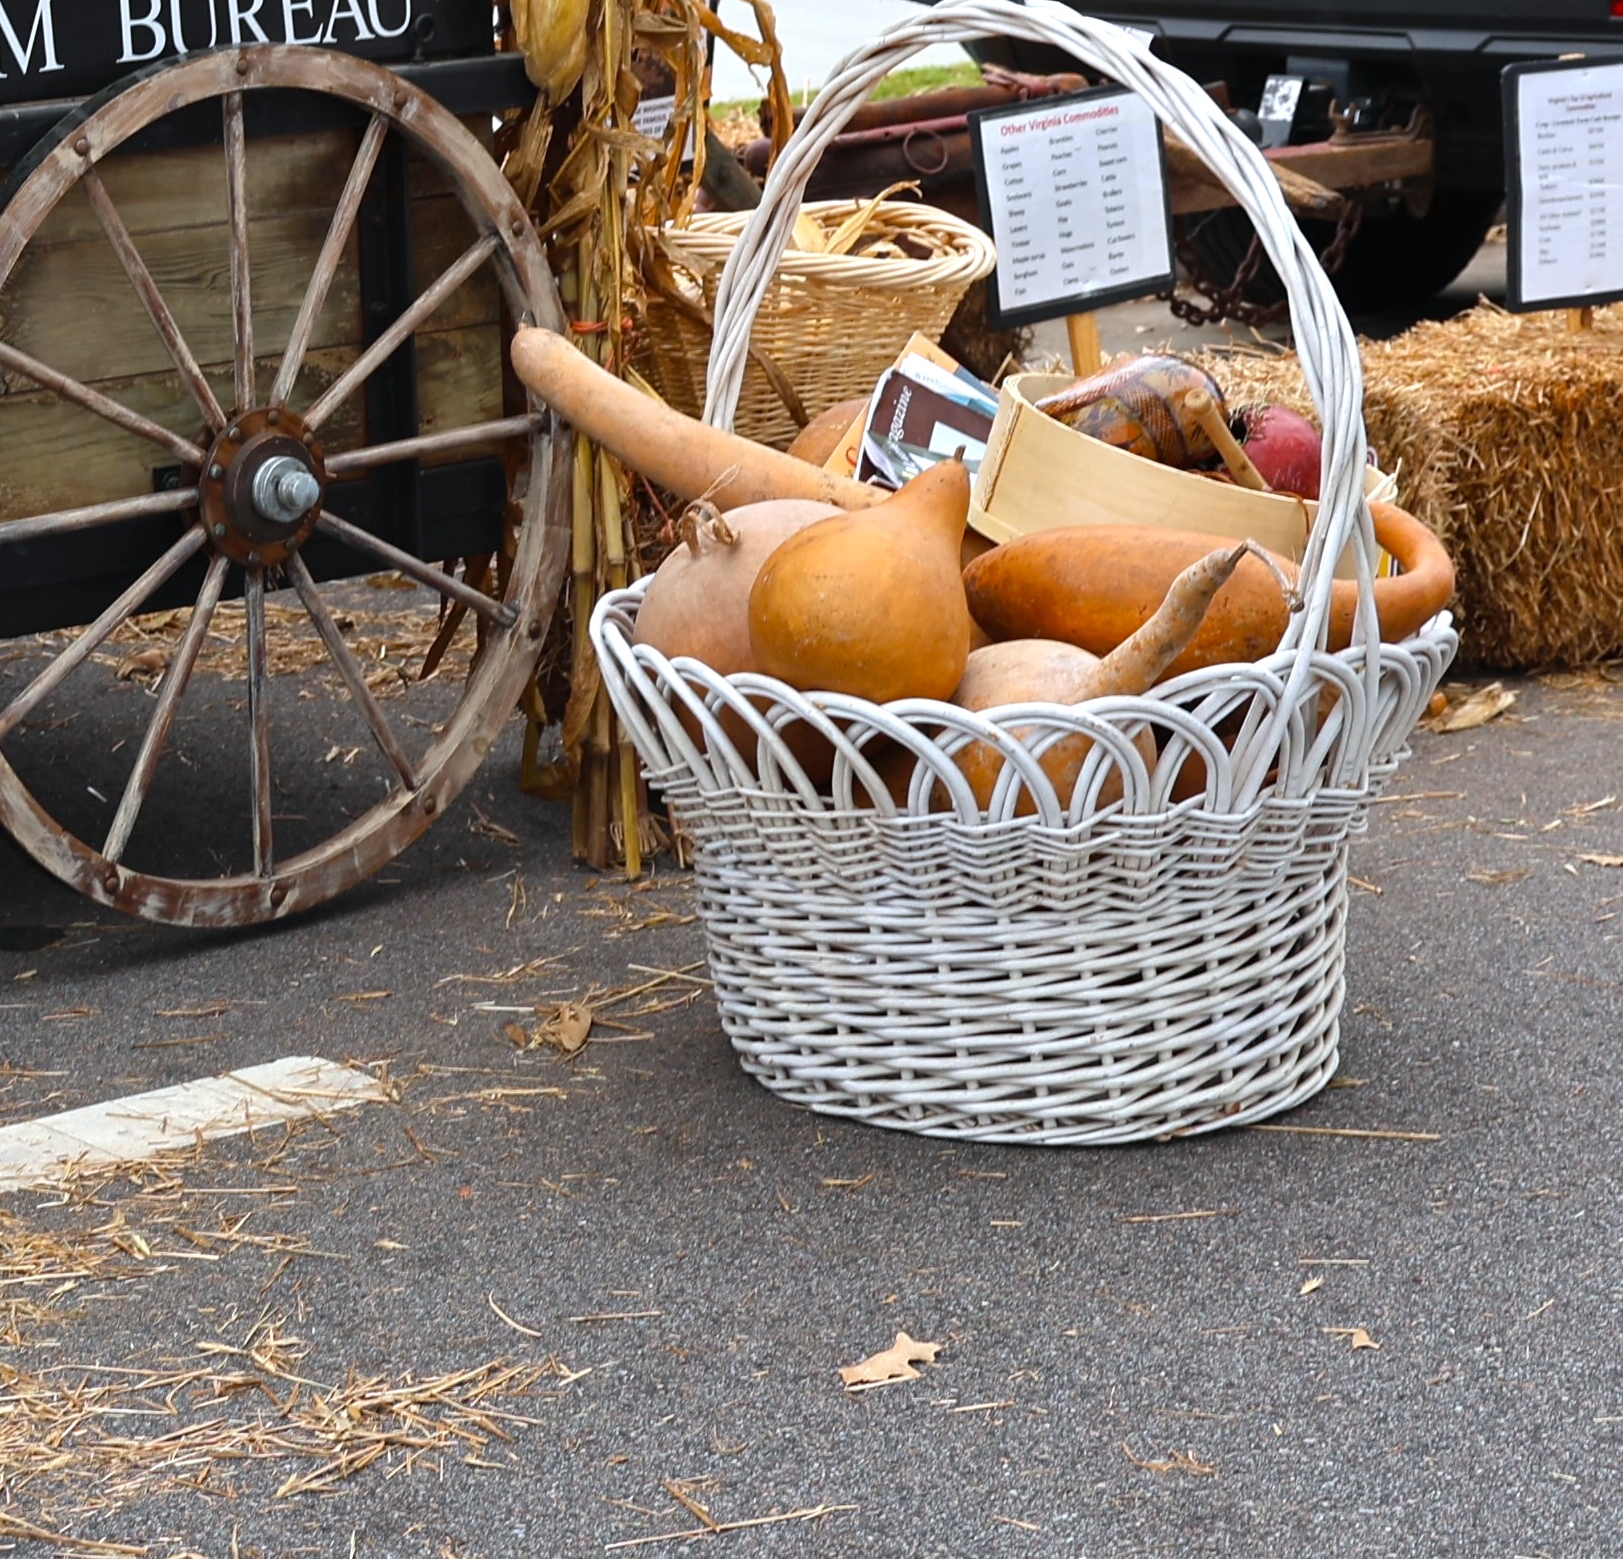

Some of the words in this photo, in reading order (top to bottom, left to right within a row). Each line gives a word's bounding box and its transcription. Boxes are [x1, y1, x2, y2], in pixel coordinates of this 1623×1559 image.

[1000, 122, 1026, 137] Other
[1028, 116, 1061, 133] Virginia
[1063, 105, 1119, 124] Commodities
